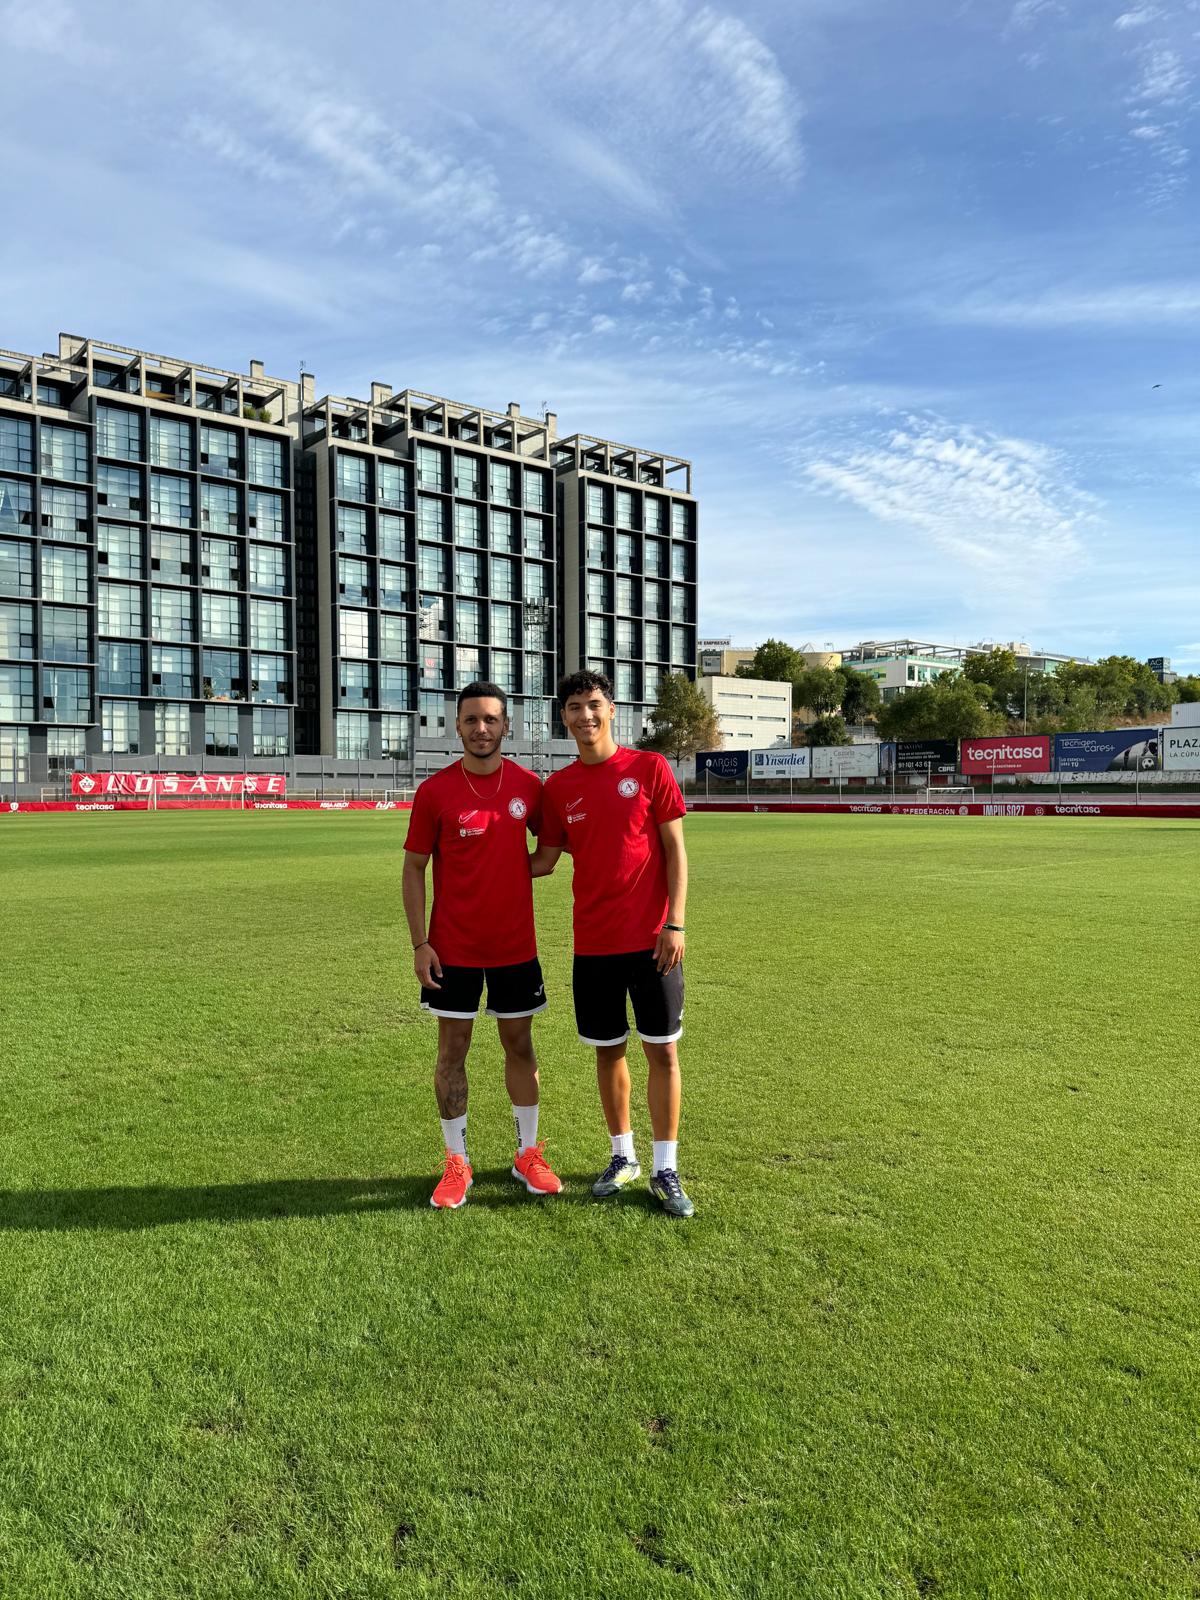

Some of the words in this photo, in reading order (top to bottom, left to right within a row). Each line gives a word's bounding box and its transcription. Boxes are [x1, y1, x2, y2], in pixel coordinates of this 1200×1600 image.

[1170, 739, 1200, 748] PLAZ
[967, 744, 1043, 760] tecnitasa
[712, 758, 738, 767] ARGIS
[766, 753, 806, 766] Ynsadiet
[1055, 804, 1101, 813] tecnitasa
